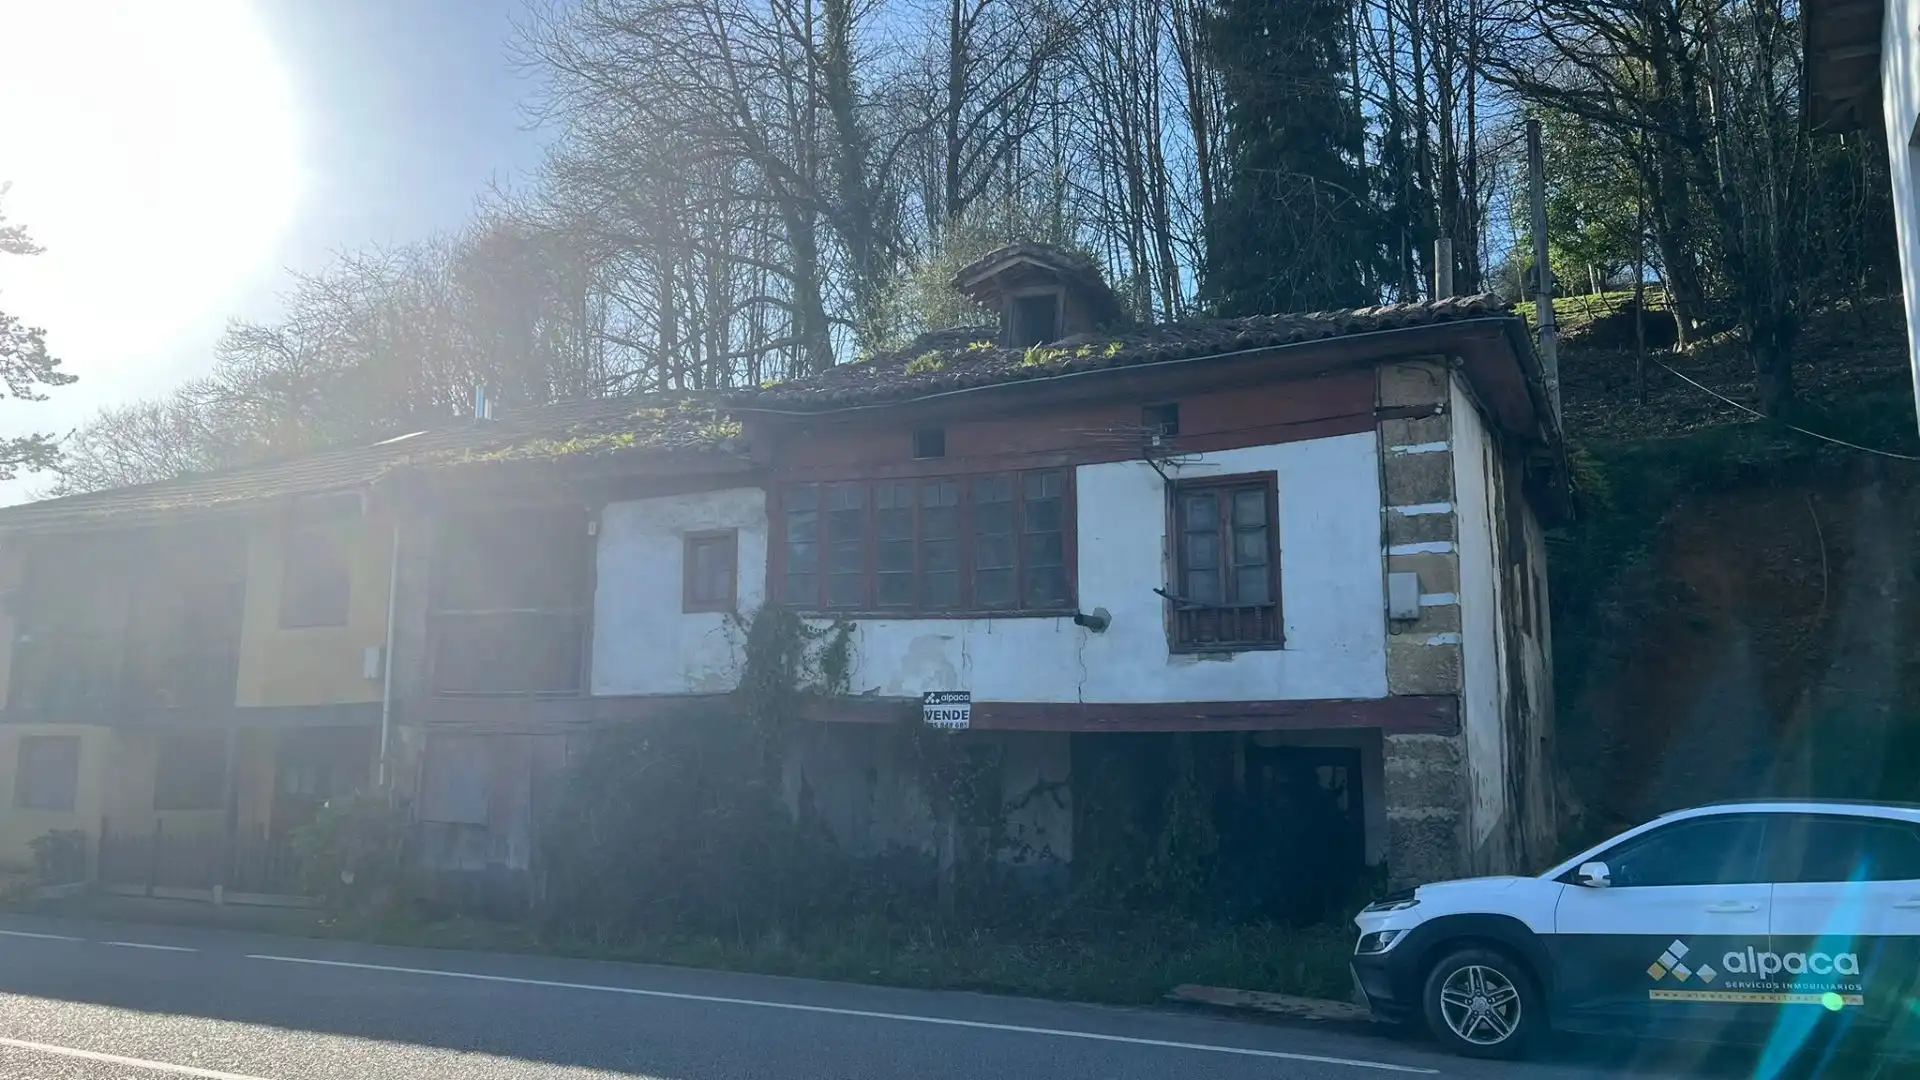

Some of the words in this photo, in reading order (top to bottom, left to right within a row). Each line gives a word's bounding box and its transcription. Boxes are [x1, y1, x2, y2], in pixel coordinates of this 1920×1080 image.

[941, 693, 969, 702] alpaca
[925, 710, 969, 720] VENDE
[1722, 946, 1860, 979] alpaca
[1725, 981, 1780, 990] SERVICIOS
[1782, 983, 1862, 991] INMOBILIARIOS
